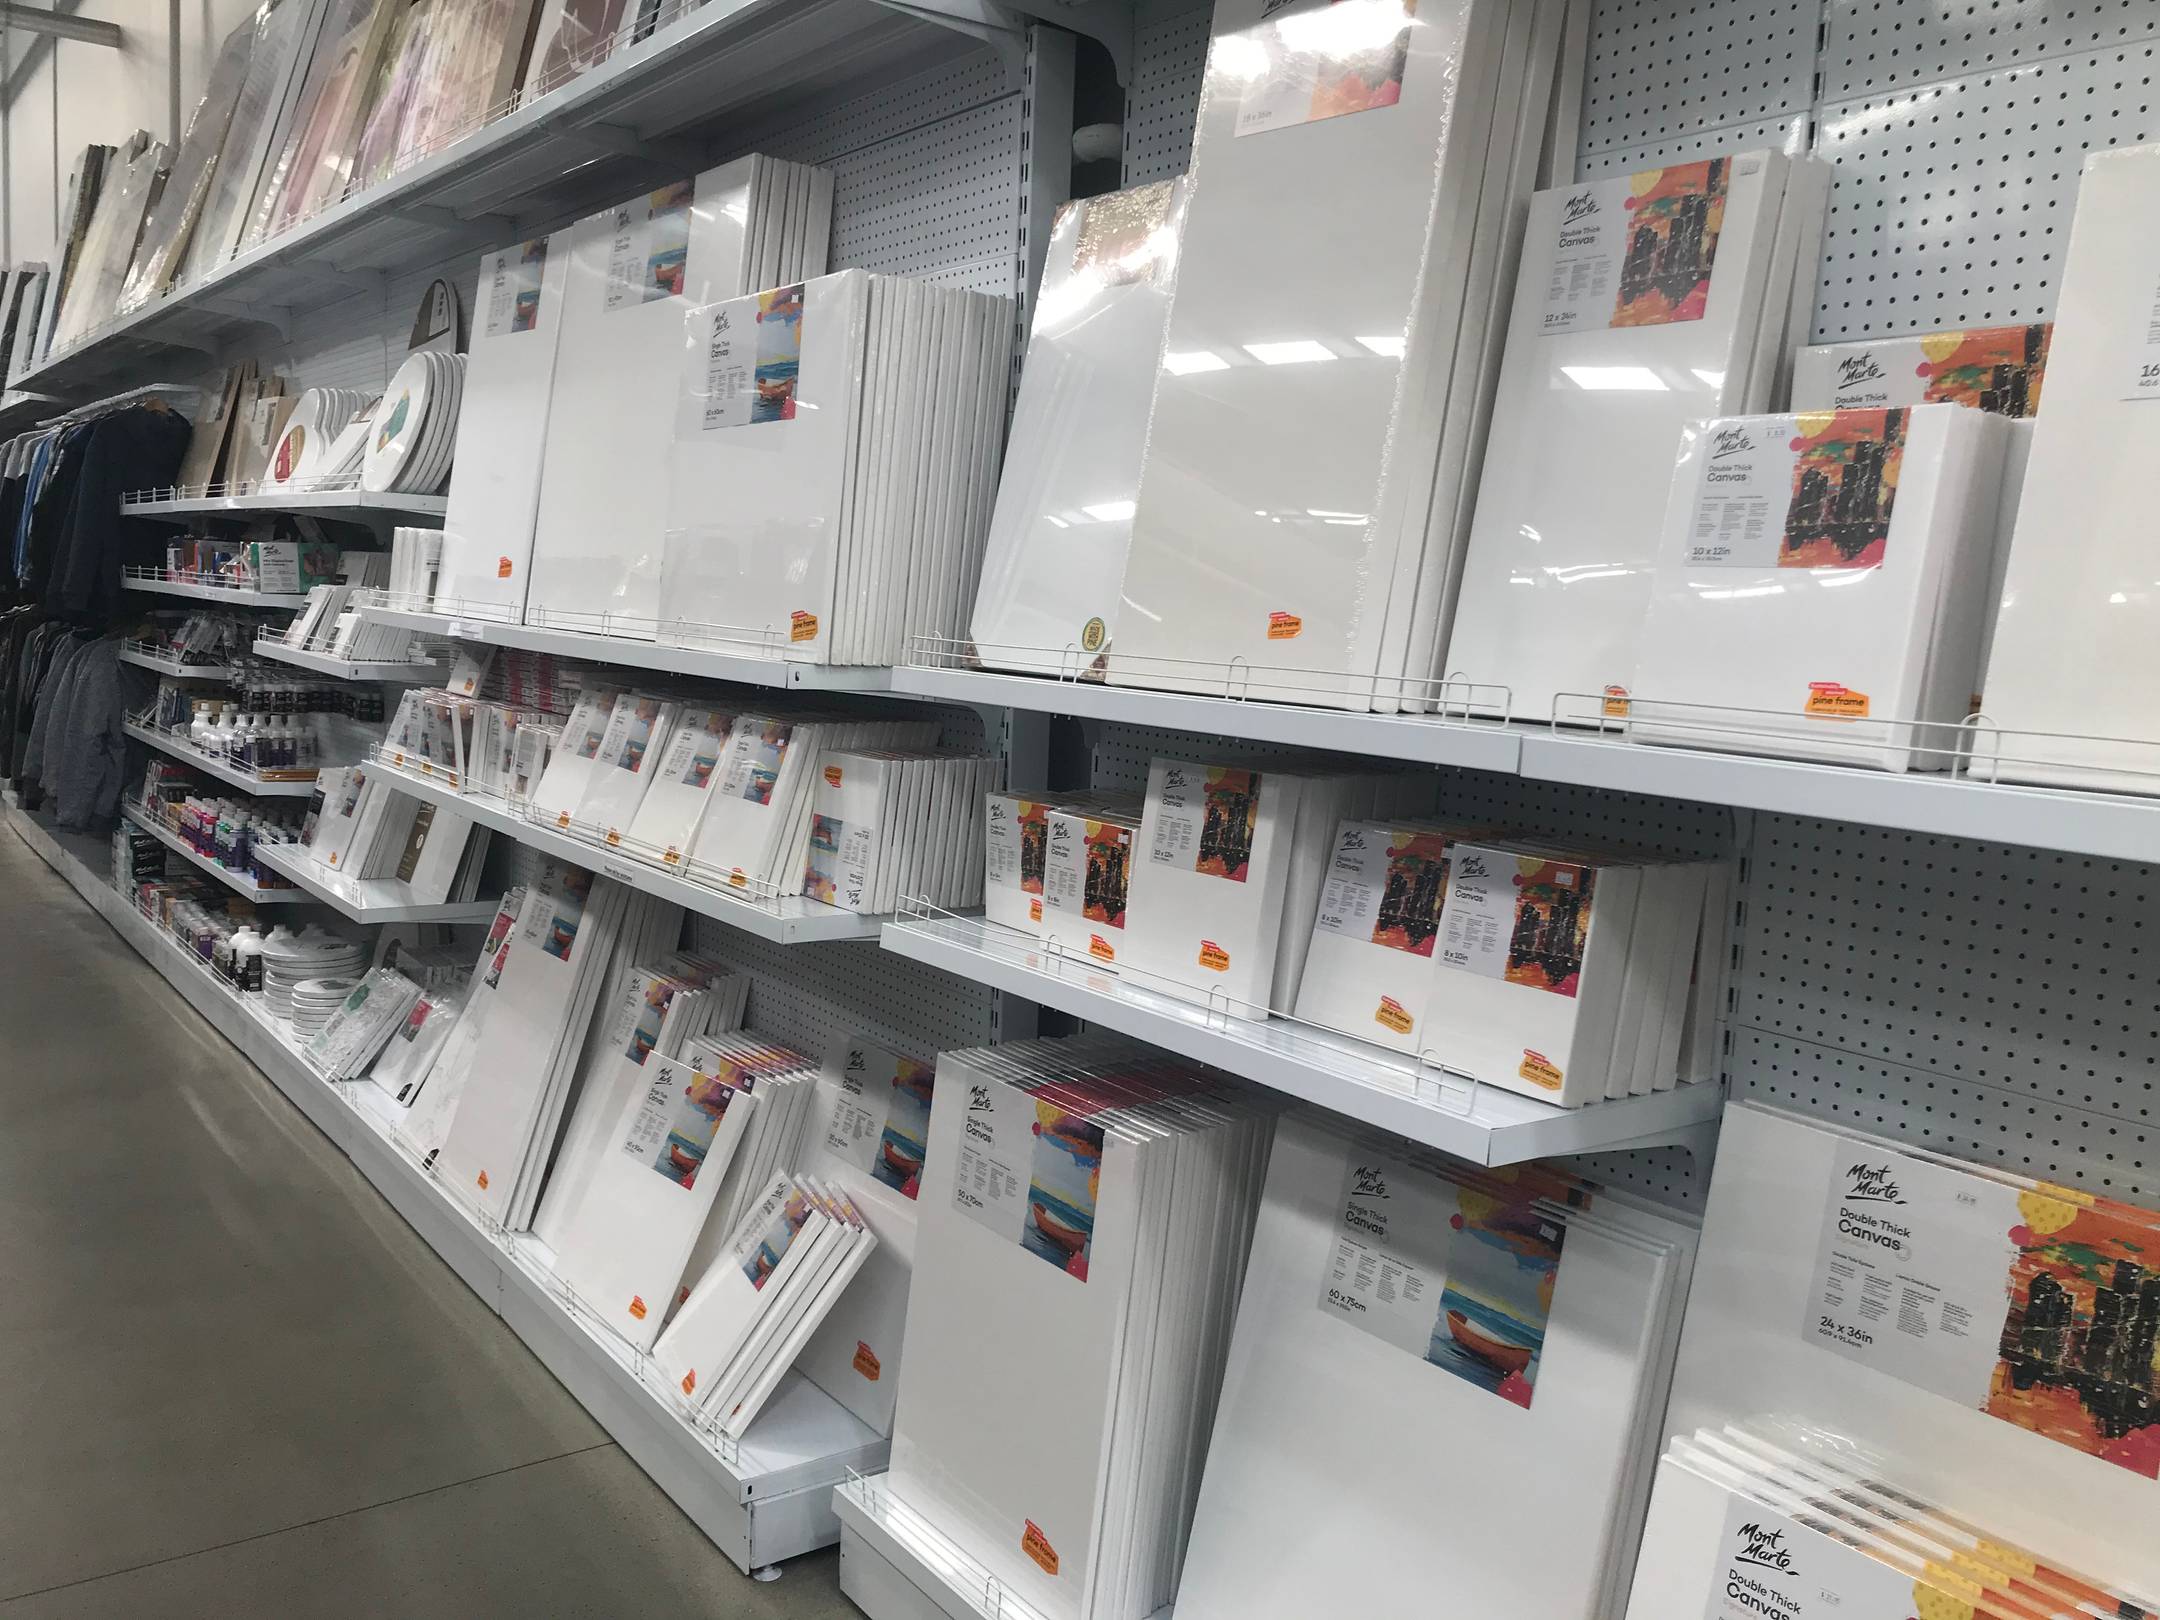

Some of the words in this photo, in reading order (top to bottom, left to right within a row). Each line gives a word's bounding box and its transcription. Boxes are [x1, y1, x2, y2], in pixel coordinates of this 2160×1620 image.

[1838, 352, 1872, 374] Mont
[1835, 395, 1862, 404] Double
[1865, 393, 1888, 402] Thick
[1713, 428, 1743, 445] Mont
[1707, 472, 1747, 483] Canvas
[1812, 696, 1833, 705] pine
[1835, 697, 1864, 706] frame
[1460, 855, 1481, 867] Mont
[1455, 890, 1484, 903] Canvas
[966, 1123, 992, 1144] Canvas
[1353, 1166, 1381, 1183] Mont
[1846, 1163, 1892, 1184] Mont
[1351, 1180, 1391, 1199] Marte
[1845, 1181, 1907, 1204] Marte
[1345, 1210, 1384, 1236] Canvas
[1347, 1201, 1368, 1216] Single
[1369, 1208, 1388, 1224] Thick
[1840, 1207, 1877, 1227] Double
[1880, 1219, 1911, 1239] Thick
[1838, 1219, 1901, 1251] Canvas
[1329, 1288, 1339, 1299] 60
[1346, 1296, 1366, 1312] 75cm
[1820, 1316, 1834, 1329] 24
[1847, 1326, 1873, 1344] 36in
[1737, 1523, 1784, 1549] Mont
[1735, 1543, 1800, 1576] Marte
[1728, 1568, 1768, 1597] Double
[1770, 1589, 1801, 1615] Thick
